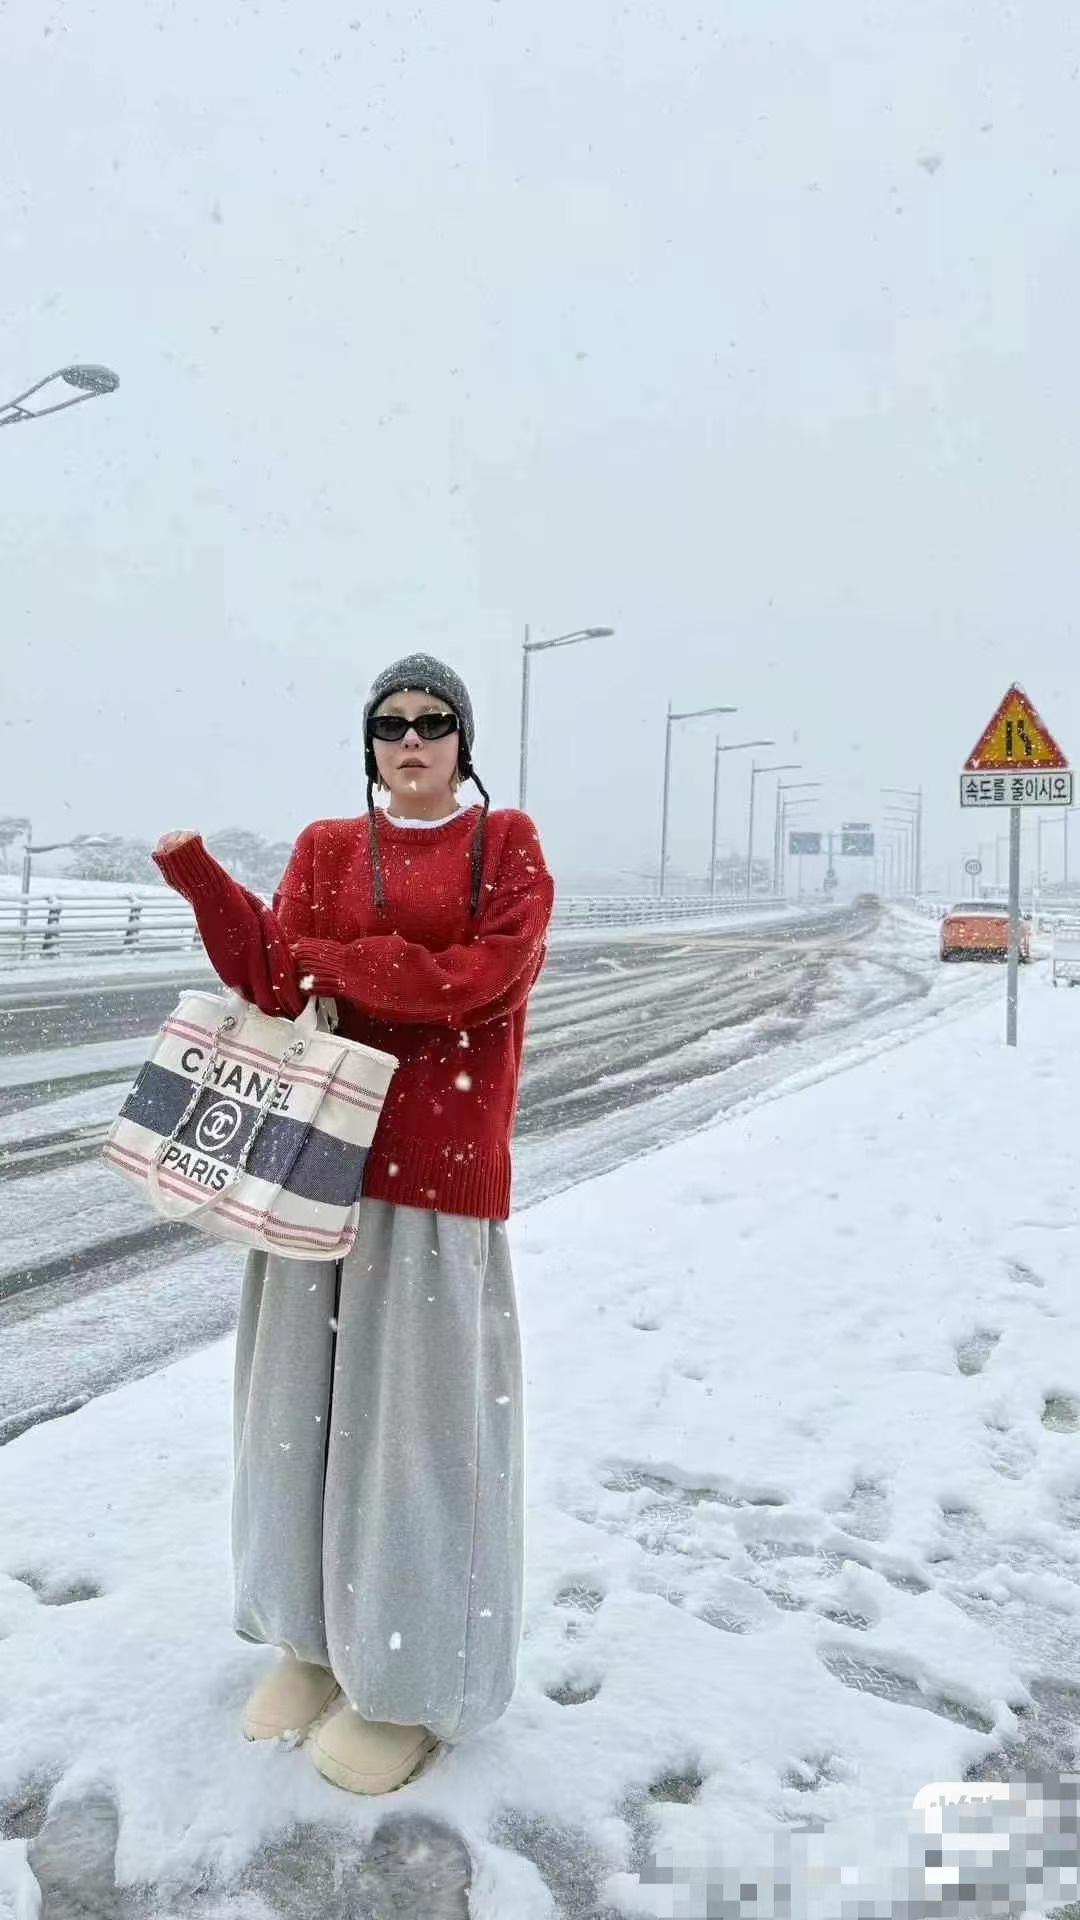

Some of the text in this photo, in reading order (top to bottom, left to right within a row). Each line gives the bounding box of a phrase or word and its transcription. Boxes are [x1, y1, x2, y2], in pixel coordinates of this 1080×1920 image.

[965, 777, 1067, 802] 속도를 줄이시오
[161, 1146, 229, 1191] PARIS
